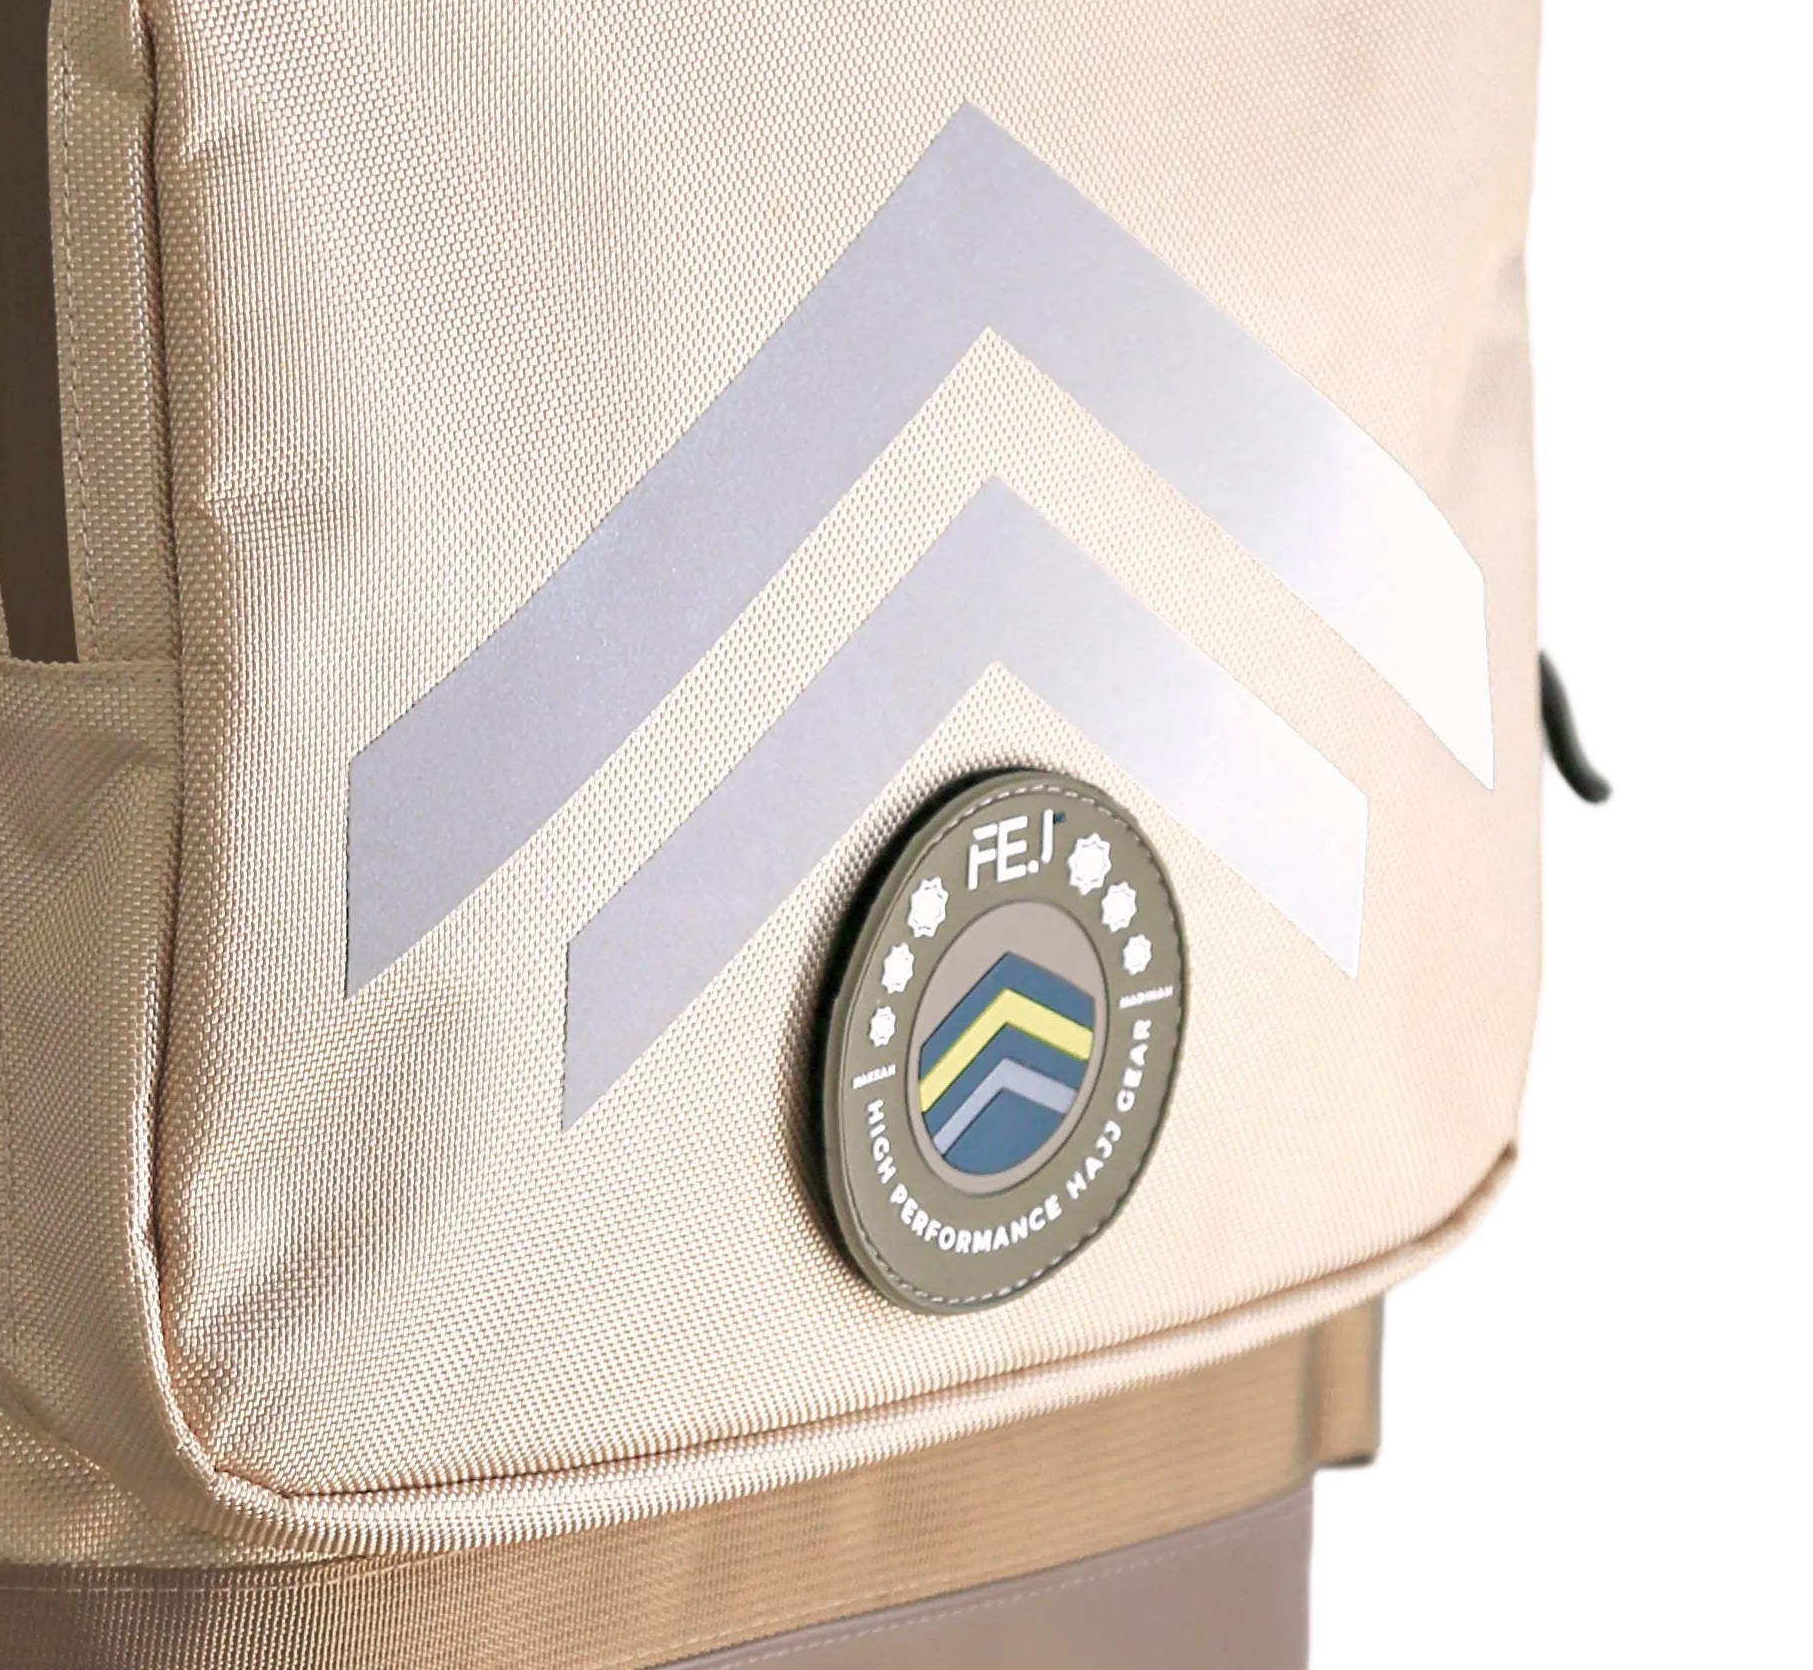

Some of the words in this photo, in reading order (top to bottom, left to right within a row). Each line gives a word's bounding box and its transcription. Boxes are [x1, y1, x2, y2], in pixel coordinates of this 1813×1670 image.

[867, 1098, 897, 1184] HIGH
[890, 1183, 1063, 1254] PERFORMANCE
[1066, 1120, 1122, 1200] HAJJ
[1116, 1019, 1152, 1112] GEAR
